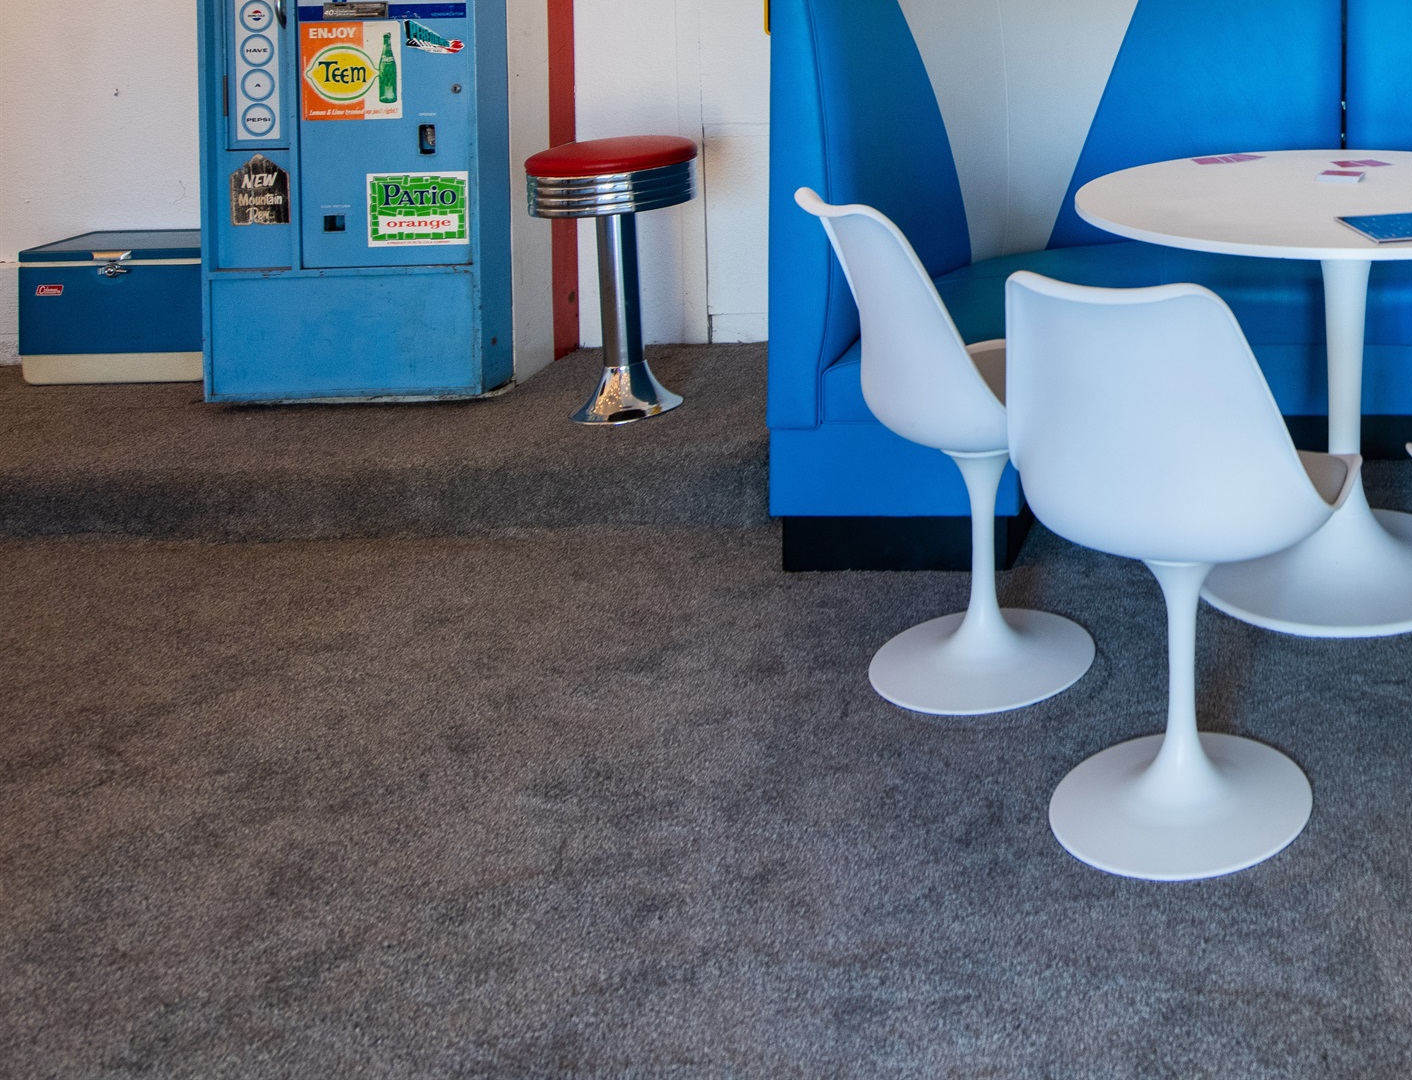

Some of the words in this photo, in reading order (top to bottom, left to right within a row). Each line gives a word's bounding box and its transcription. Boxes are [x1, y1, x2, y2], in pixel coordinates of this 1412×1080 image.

[308, 27, 356, 39] ENJOY
[318, 61, 367, 84] Teem
[241, 172, 278, 189] NEW
[238, 193, 283, 206] Mountain
[383, 184, 457, 206] PATiO
[246, 206, 271, 222] Dew
[386, 220, 451, 230] orange
